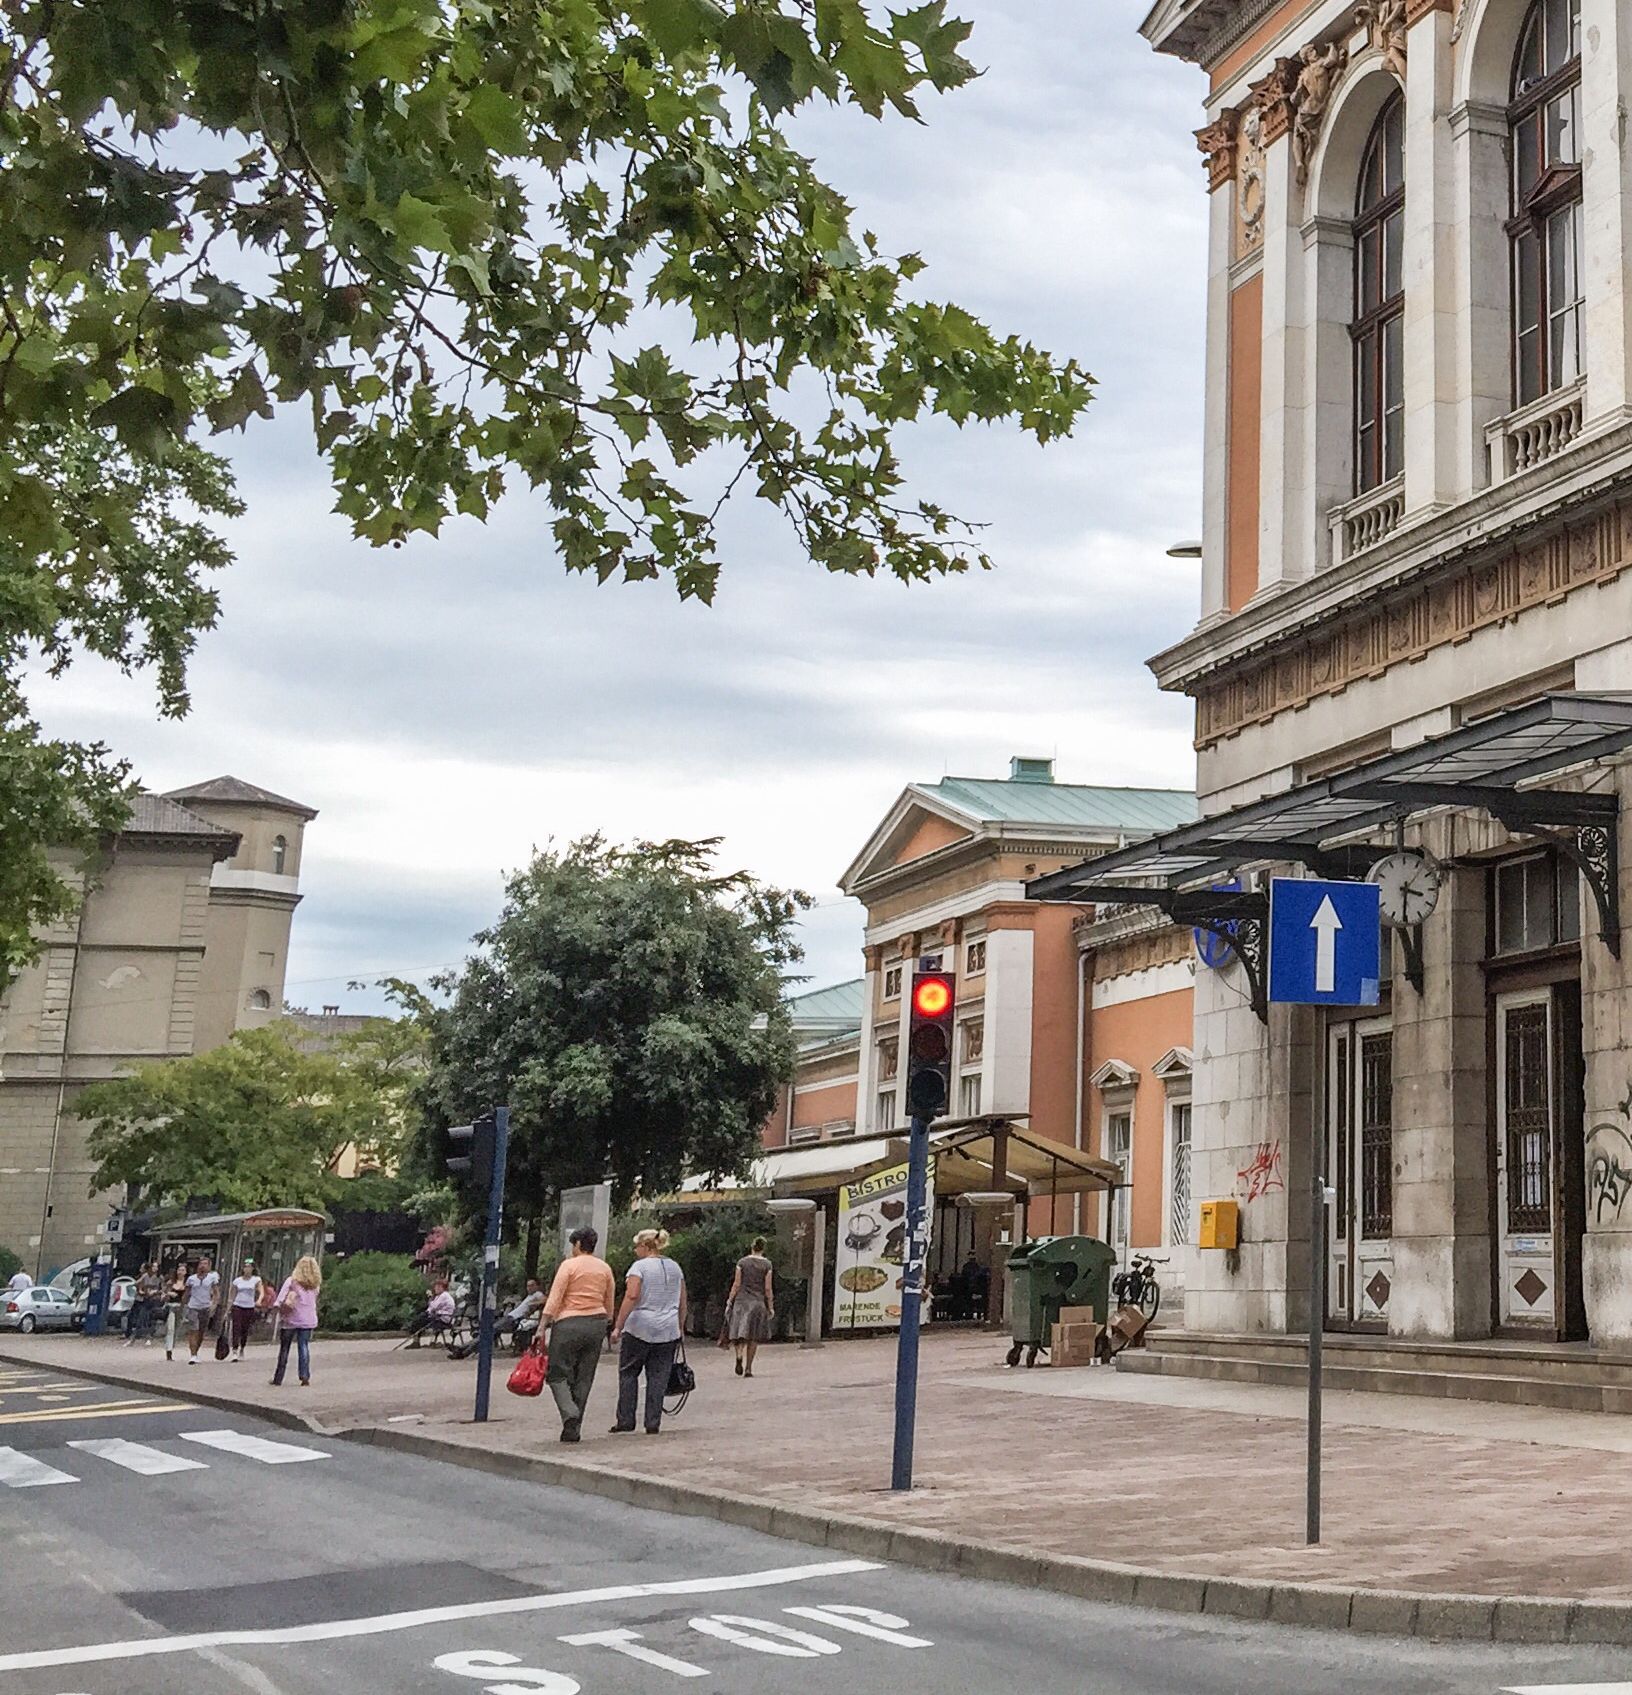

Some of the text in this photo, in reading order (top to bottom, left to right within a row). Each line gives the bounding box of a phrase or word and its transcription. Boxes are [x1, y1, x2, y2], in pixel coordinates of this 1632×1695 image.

[847, 1170, 908, 1199] BISTRO
[839, 1314, 884, 1324] FRSTUCK
[433, 1603, 936, 1695] STOP
